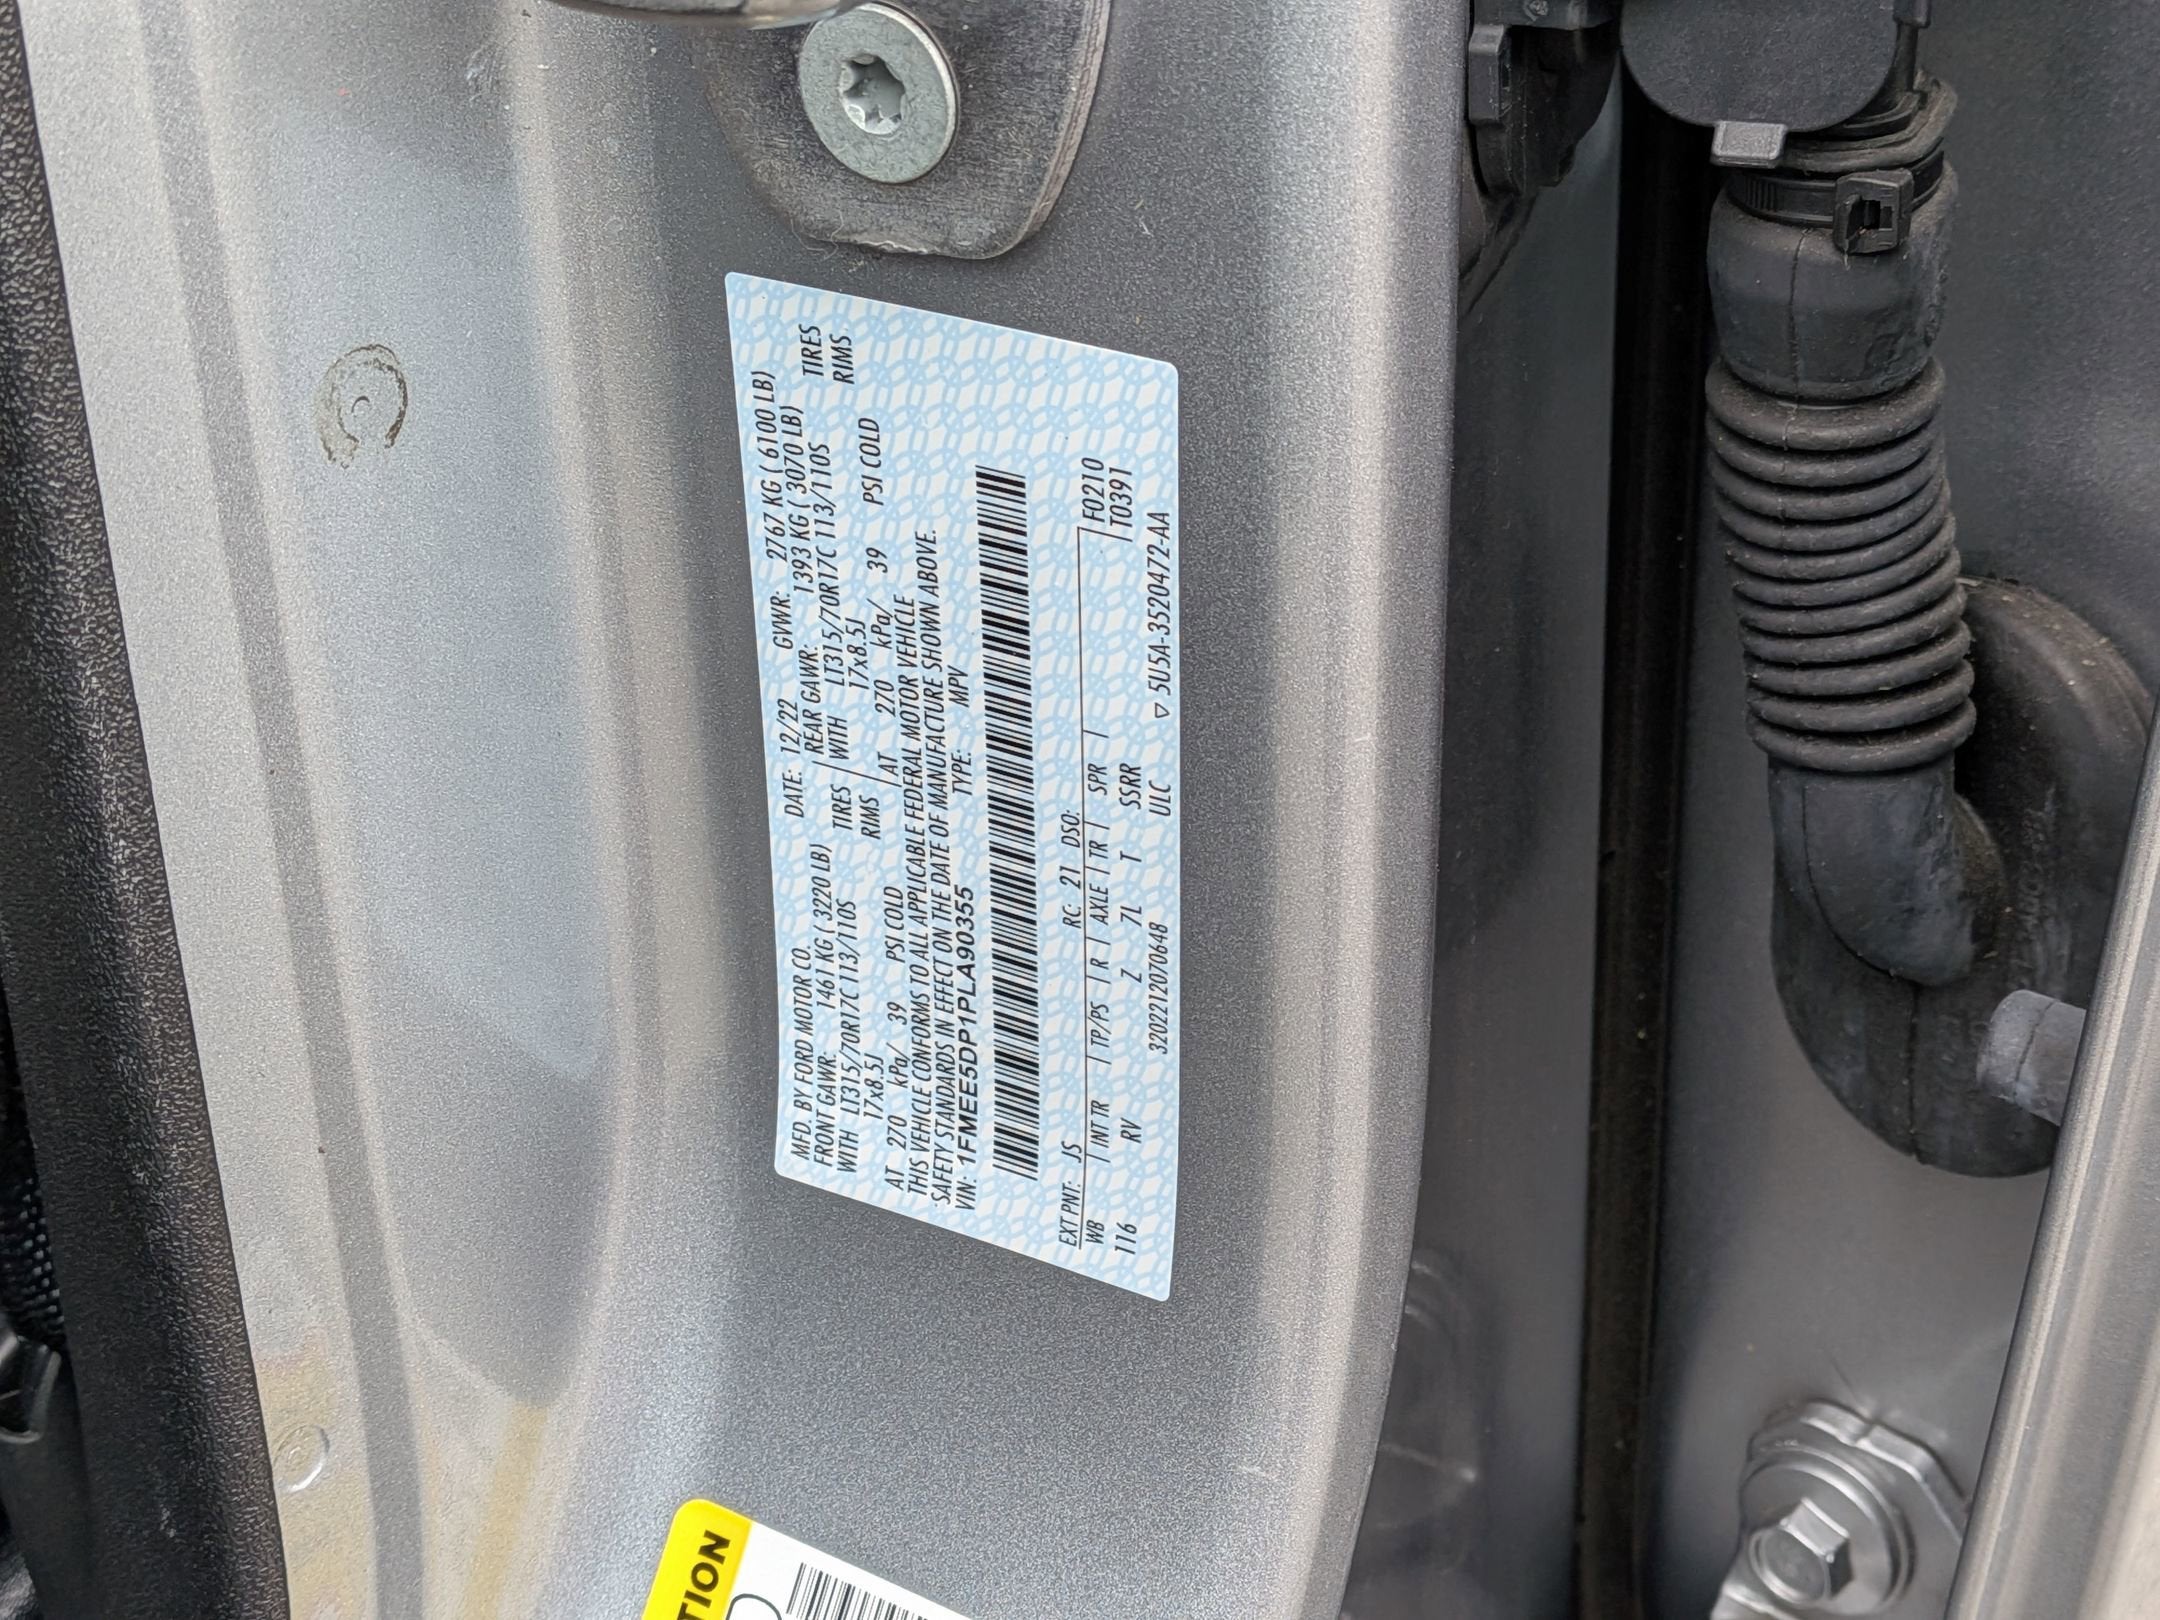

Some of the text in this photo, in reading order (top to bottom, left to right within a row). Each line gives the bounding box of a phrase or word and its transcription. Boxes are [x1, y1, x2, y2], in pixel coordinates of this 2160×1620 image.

[799, 324, 823, 376] TIRES
[830, 333, 854, 385] RIMS
[751, 371, 775, 403] LB)
[755, 409, 779, 459] 6100
[779, 406, 803, 437] LB)
[783, 443, 807, 494] 3070
[1081, 457, 1105, 523] F0210
[760, 480, 783, 507] KG
[1109, 466, 1133, 527] T0391
[763, 512, 787, 562] 2767
[788, 513, 810, 541] KG
[791, 546, 814, 594] 1393
[770, 591, 793, 650] GVWR:
[808, 442, 849, 760] WITH LT315/70R17C 113/110S
[858, 417, 898, 776] AT 270 kPa/ 39 PSI COLD
[1146, 511, 1171, 696] 5U5A-3520472-AA
[799, 644, 820, 703] GAWR:
[845, 617, 869, 690] 17x8.5J
[802, 709, 824, 755] REAR
[947, 665, 972, 795] TYPE: MPV
[776, 698, 804, 818] DATE: 12/22
[1088, 763, 1107, 795] SPR
[831, 784, 853, 830] TIRES
[1119, 763, 1142, 809] SSRR
[1148, 780, 1171, 816] ULC
[859, 795, 880, 840] RIMS
[1061, 810, 1081, 848] DSO:
[809, 843, 832, 873] LB)
[915, 530, 955, 1205] SAFETY STANDARDS IN EFFECT ON THE DATE OF MANUFACTURE SHOWN ABOVE.
[1089, 840, 1108, 859] TR
[1120, 851, 1142, 862] T
[811, 877, 832, 921] 3220
[893, 594, 932, 1196] THIS VEHICLE CONFORMS TO ALL APPLICABLE FEDERAL MOTOR VEHICLE
[1060, 865, 1082, 929] RC: 21
[1089, 883, 1109, 925] AXLE
[1120, 905, 1142, 927] 7L
[814, 939, 834, 963] KG
[1090, 958, 1109, 970] R
[1120, 968, 1142, 983] Z
[816, 968, 835, 1009] 1461
[1148, 922, 1168, 1054] 3202212070648
[835, 899, 862, 1173] WITH LT315/70R17C 113/110S
[884, 886, 909, 1191] AT 270 kPa/ 39 PSI COLD
[954, 885, 977, 1210] VIN: 1FMEE5DP1PLA90355
[1088, 1001, 1112, 1048] TP/PS
[791, 945, 813, 1160] MFD. BY FORD MOTOR CO.
[817, 1051, 836, 1107] GAWR:
[863, 1053, 884, 1120] 17x8.5J
[814, 1109, 835, 1167] FRONT
[1090, 1100, 1110, 1148] INT TR
[1120, 1117, 1142, 1143] RV
[1059, 1141, 1082, 1247] EXT PNT: JS
[1086, 1219, 1105, 1245] WB
[1114, 1222, 1137, 1255] 116
